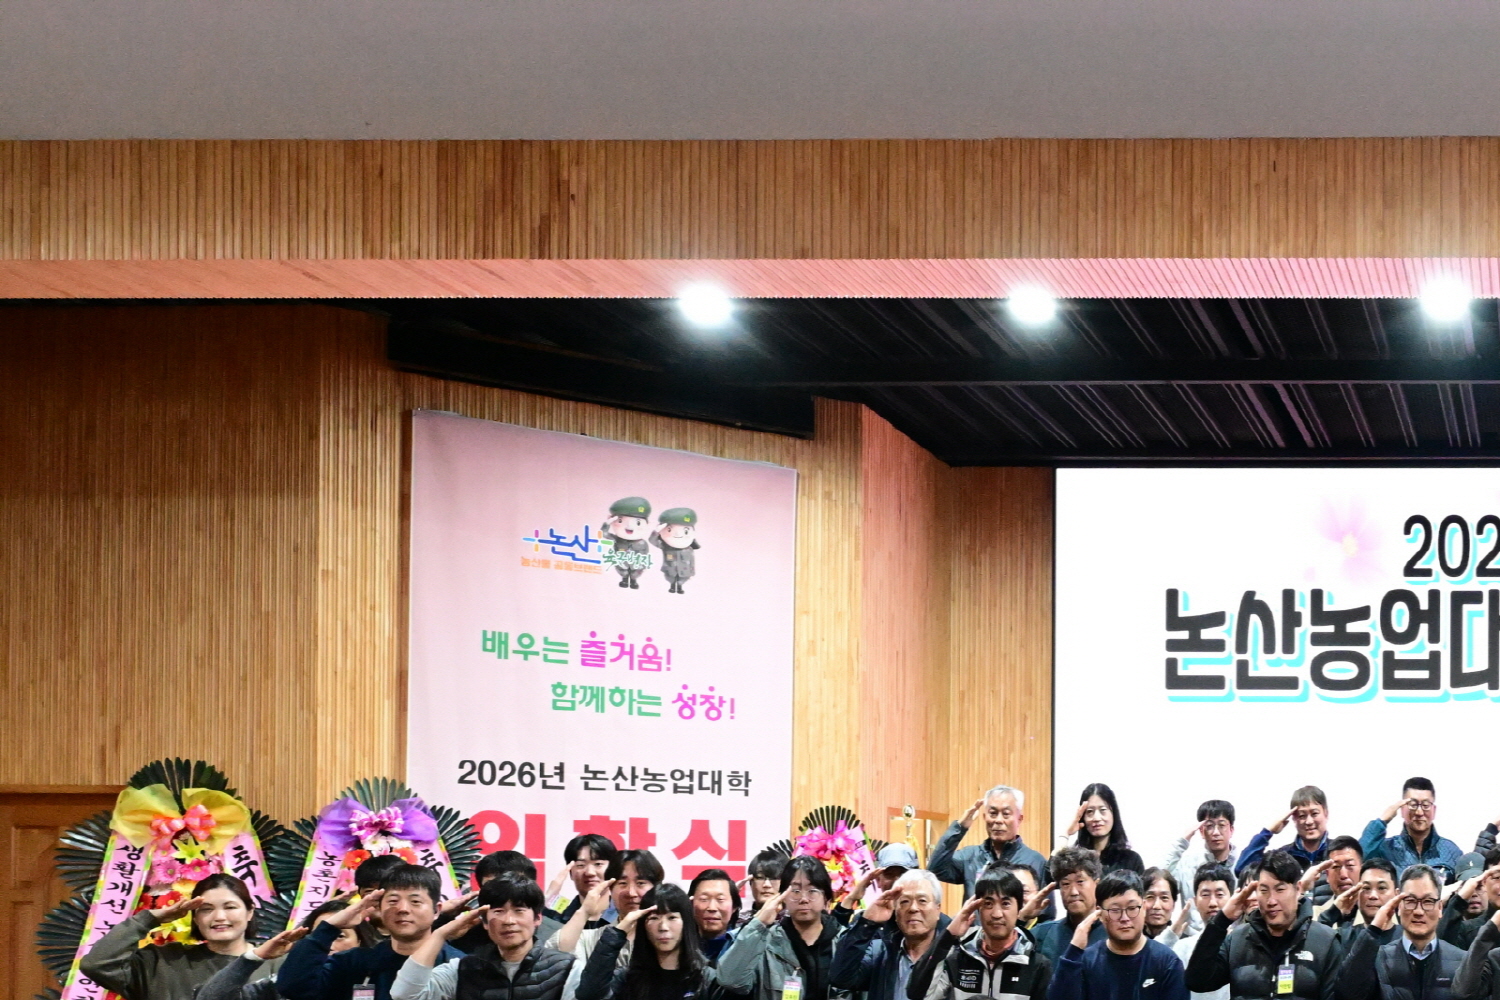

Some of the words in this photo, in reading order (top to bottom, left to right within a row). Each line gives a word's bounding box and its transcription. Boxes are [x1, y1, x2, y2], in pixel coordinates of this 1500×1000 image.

[481, 629, 570, 666] 배우는
[580, 630, 672, 672] 즐거움!
[550, 681, 662, 717] 함께하는
[672, 683, 736, 722] 성장!
[457, 759, 566, 790] 2026년
[579, 764, 752, 797] 논산농업대학
